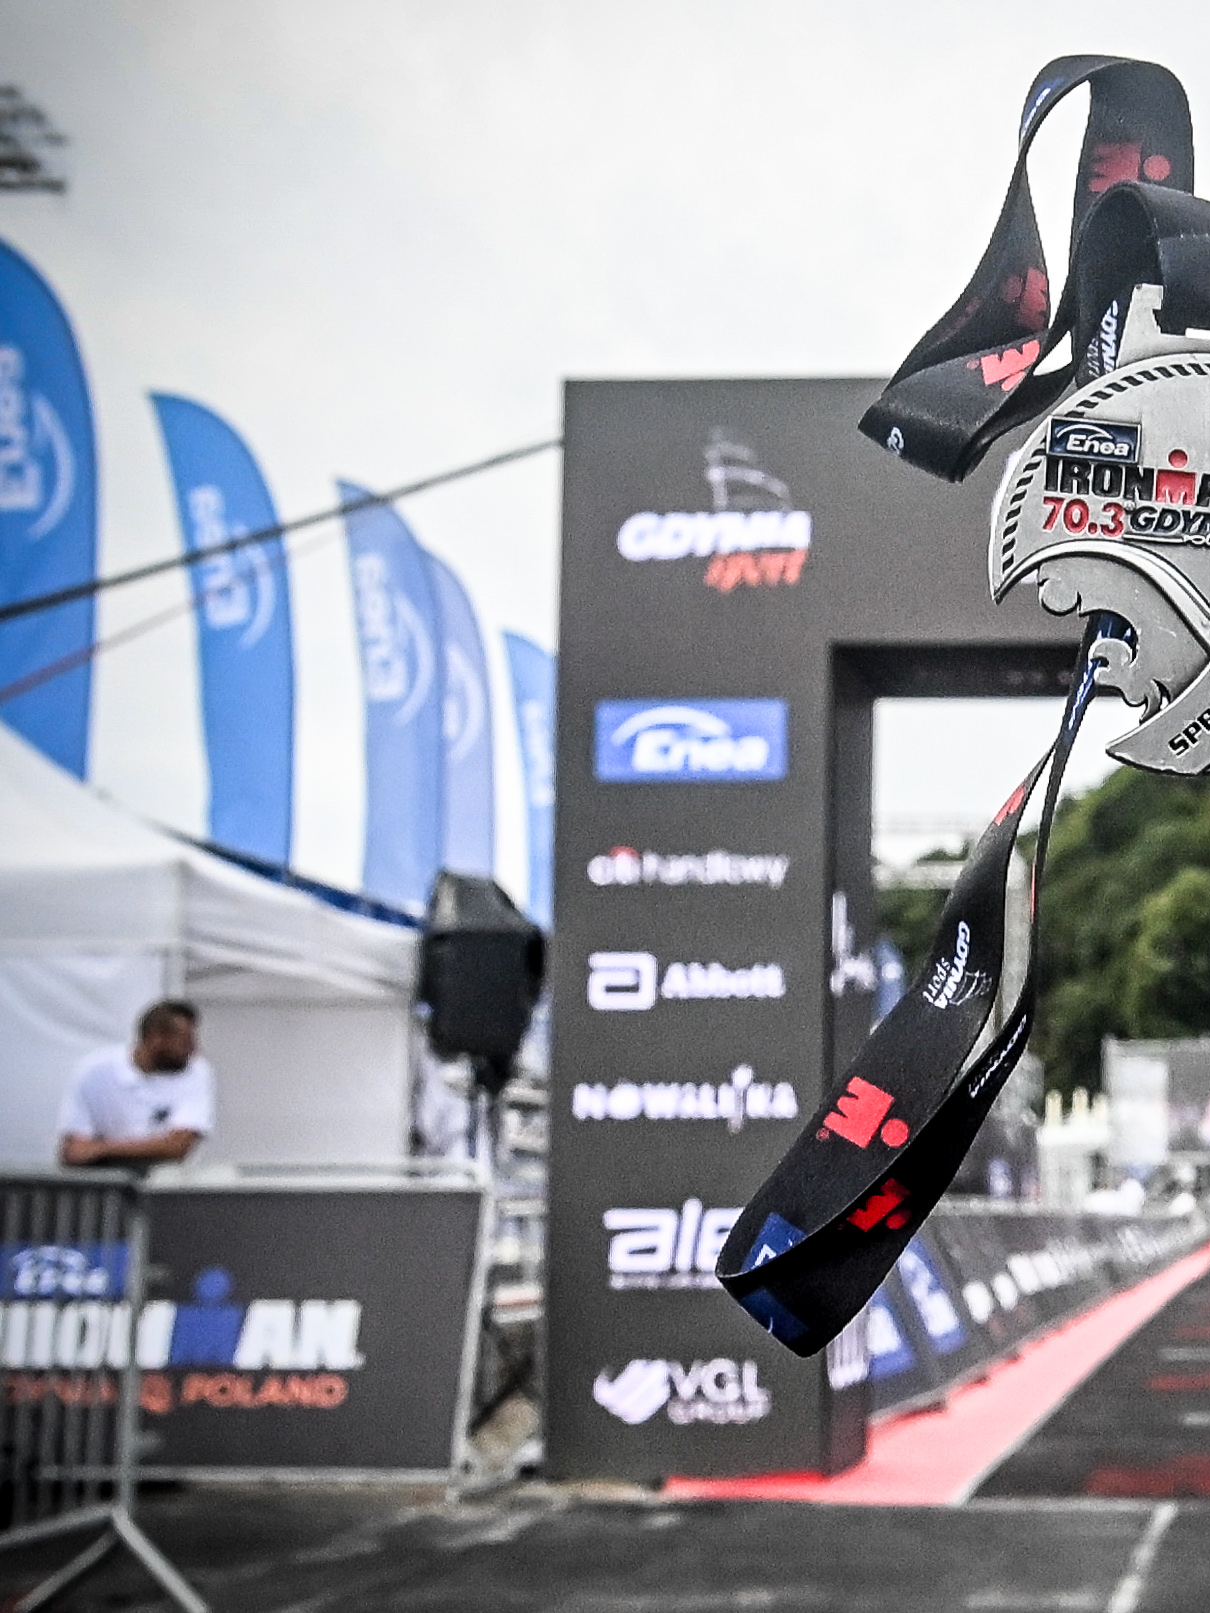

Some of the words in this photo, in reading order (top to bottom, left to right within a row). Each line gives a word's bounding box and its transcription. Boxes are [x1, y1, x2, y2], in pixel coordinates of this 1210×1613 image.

[1066, 434, 1130, 457] Enea
[1043, 496, 1125, 538] 70.3
[922, 957, 951, 1004] sport
[933, 921, 970, 1009] GDYNIA
[667, 1358, 766, 1401] VGL
